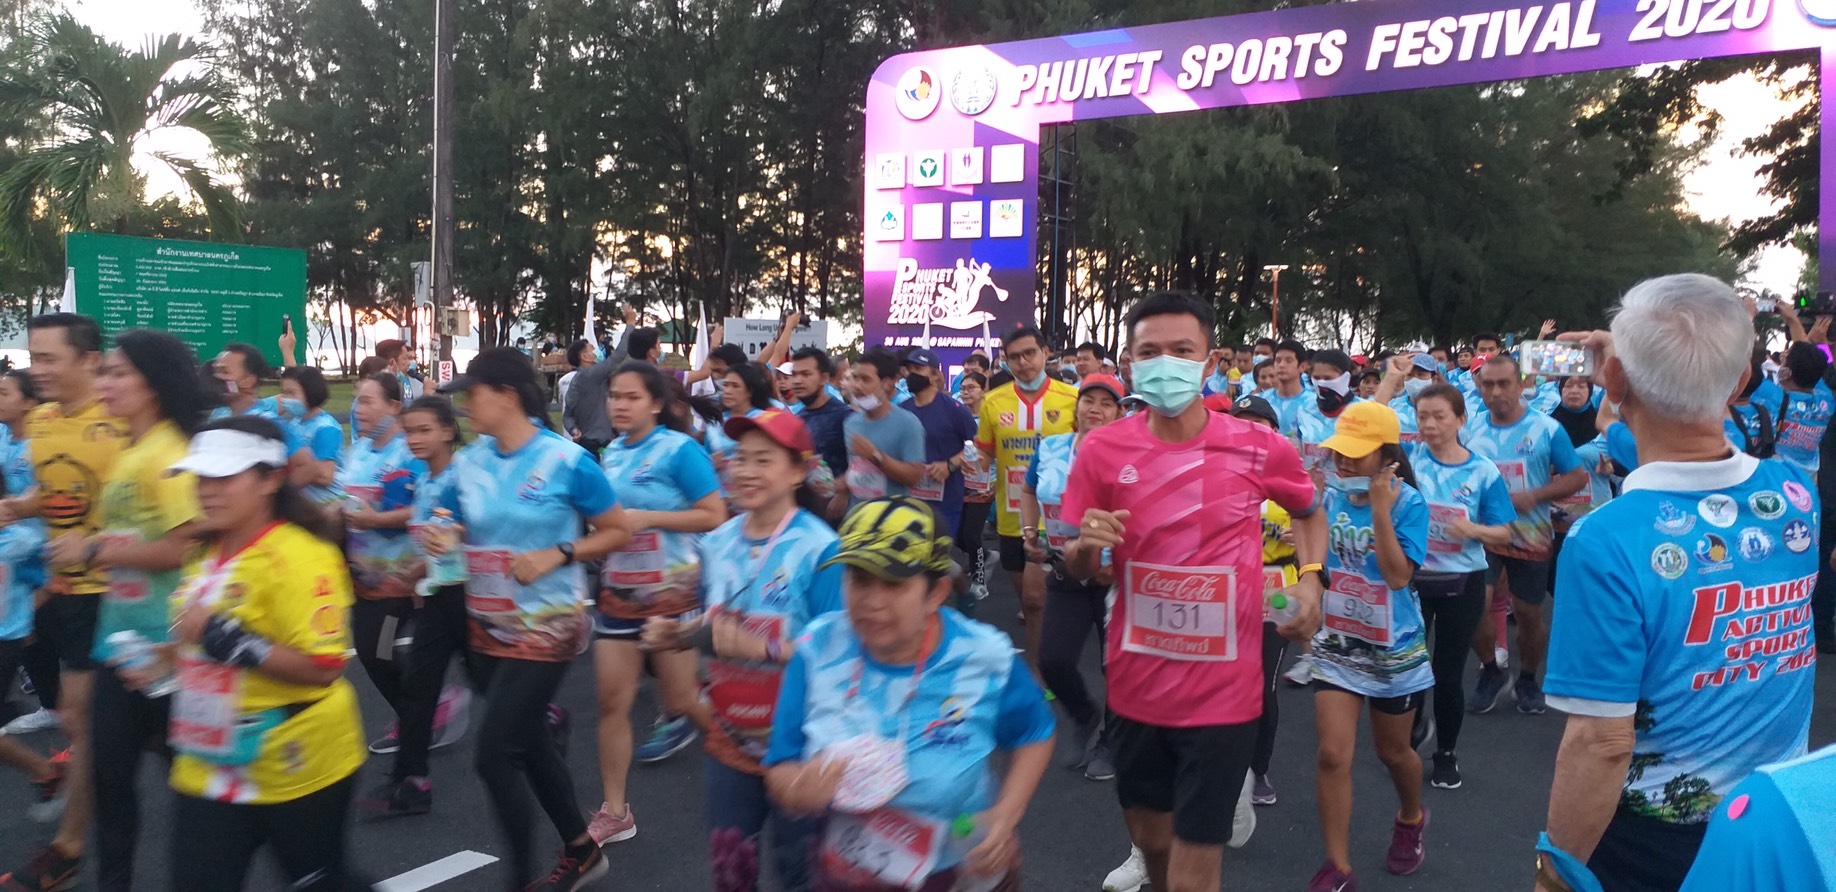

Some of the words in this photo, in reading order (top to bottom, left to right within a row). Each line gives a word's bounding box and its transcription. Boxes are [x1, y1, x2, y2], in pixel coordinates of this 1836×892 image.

[1011, 50, 1163, 107] PHUKET
[1177, 29, 1348, 90] SPORTS
[1365, 0, 1601, 71] FESTIVAL
[1628, 0, 1770, 42] 2020
[892, 257, 954, 294] PHUKET
[887, 304, 929, 325] 2020
[1140, 571, 1221, 600] Coca-Cola
[1153, 602, 1200, 630] 131
[1725, 626, 1810, 662] SPORT
